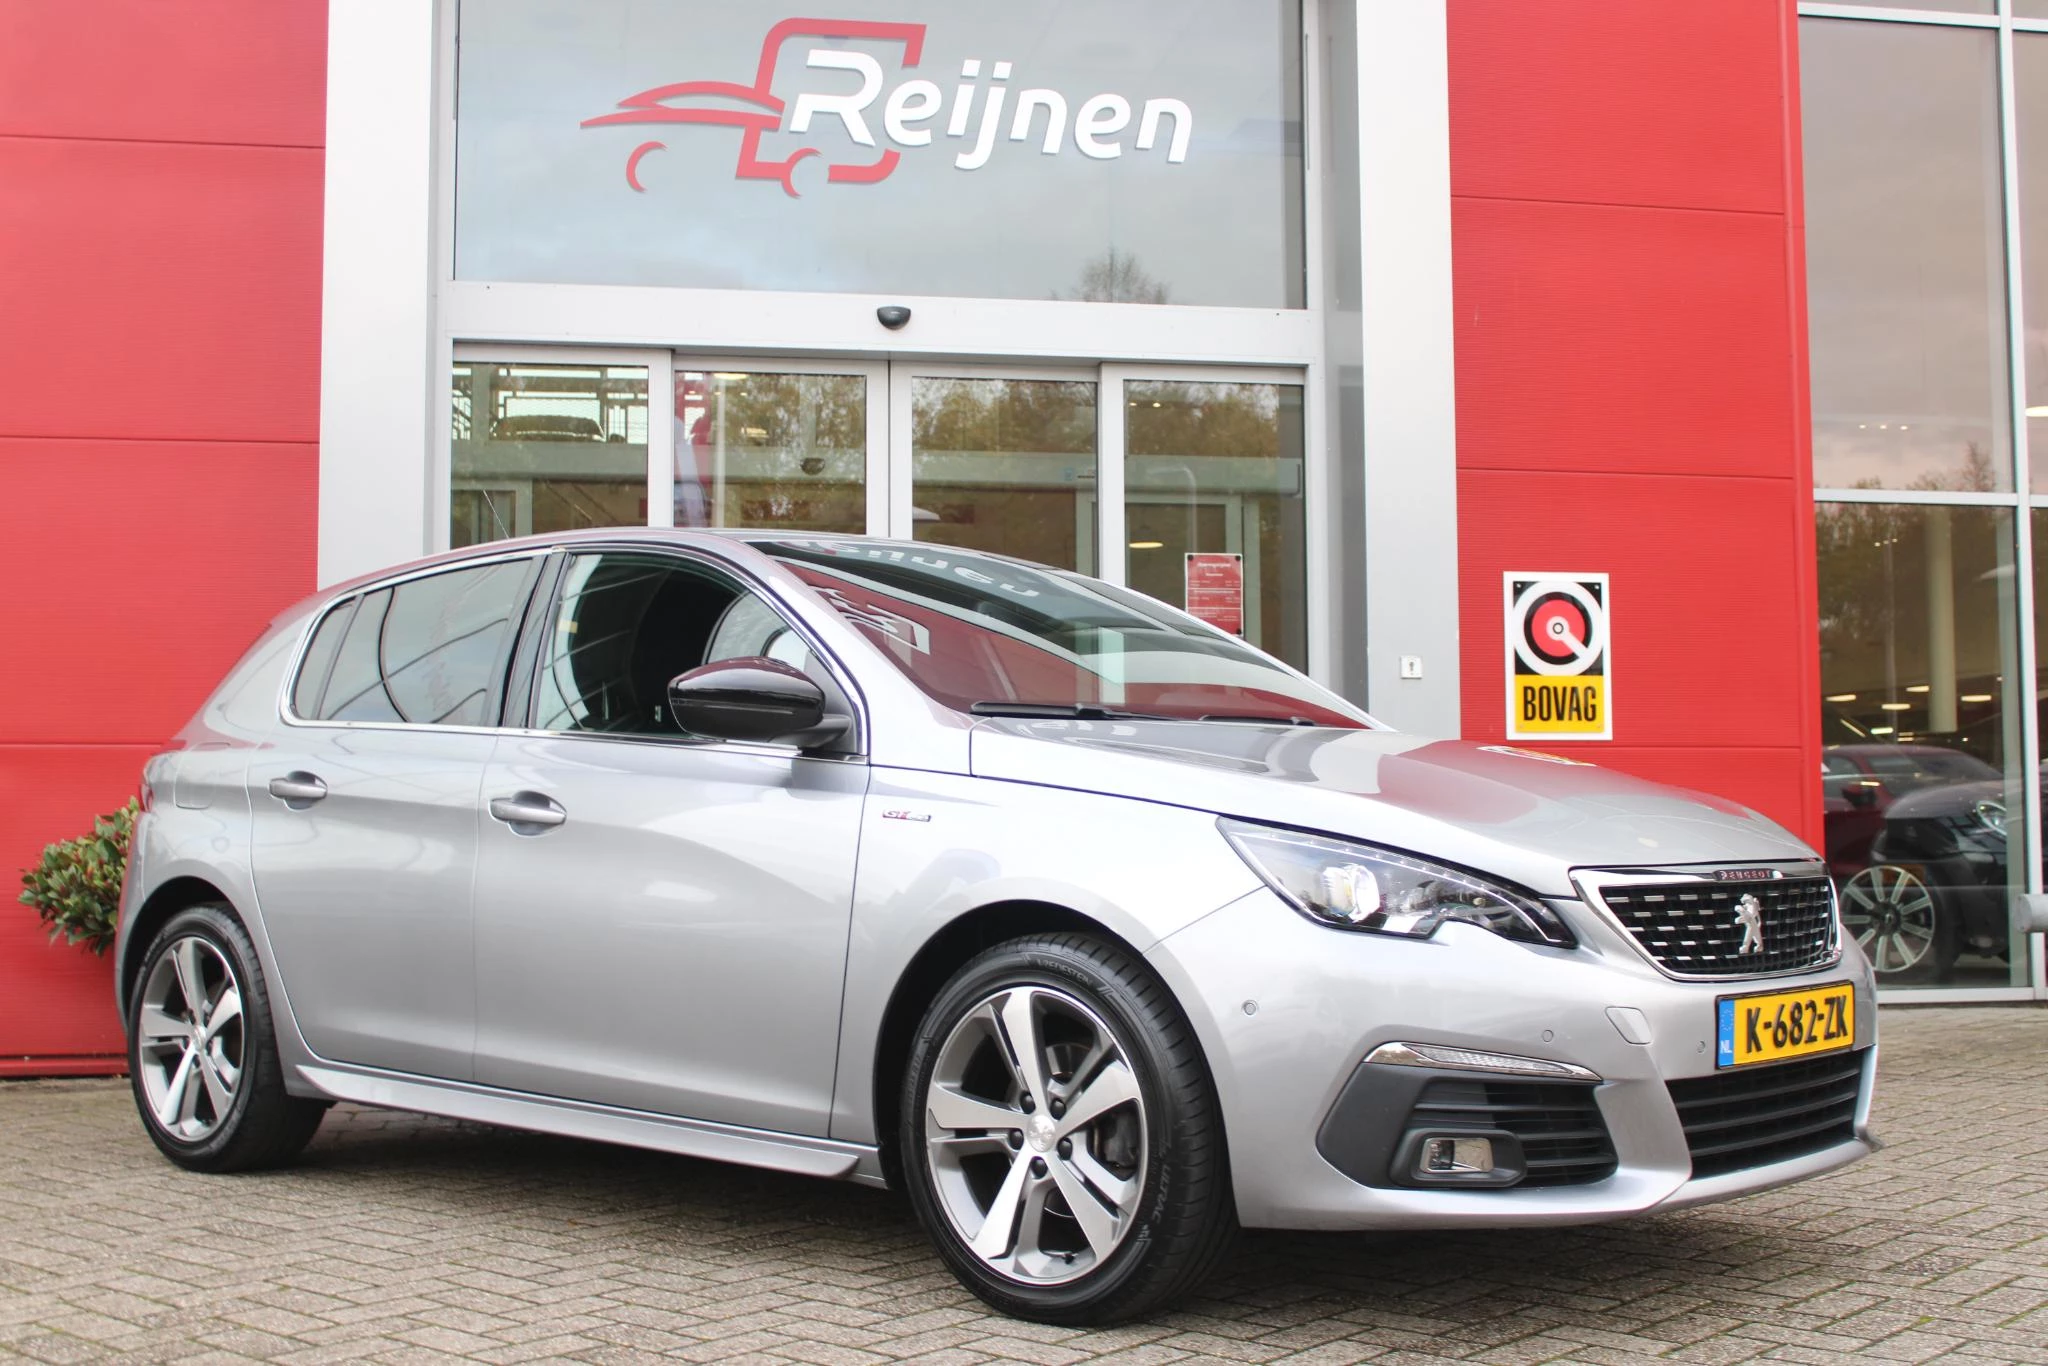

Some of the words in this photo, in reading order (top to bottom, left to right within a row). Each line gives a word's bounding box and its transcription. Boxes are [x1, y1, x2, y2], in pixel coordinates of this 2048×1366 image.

[789, 49, 1193, 170] Reijnen
[1523, 685, 1597, 721] BOVAG
[1719, 869, 1771, 880] PEUGEOT
[1746, 995, 1848, 1053] K-682-ZK
[1720, 1039, 1733, 1053] NL
